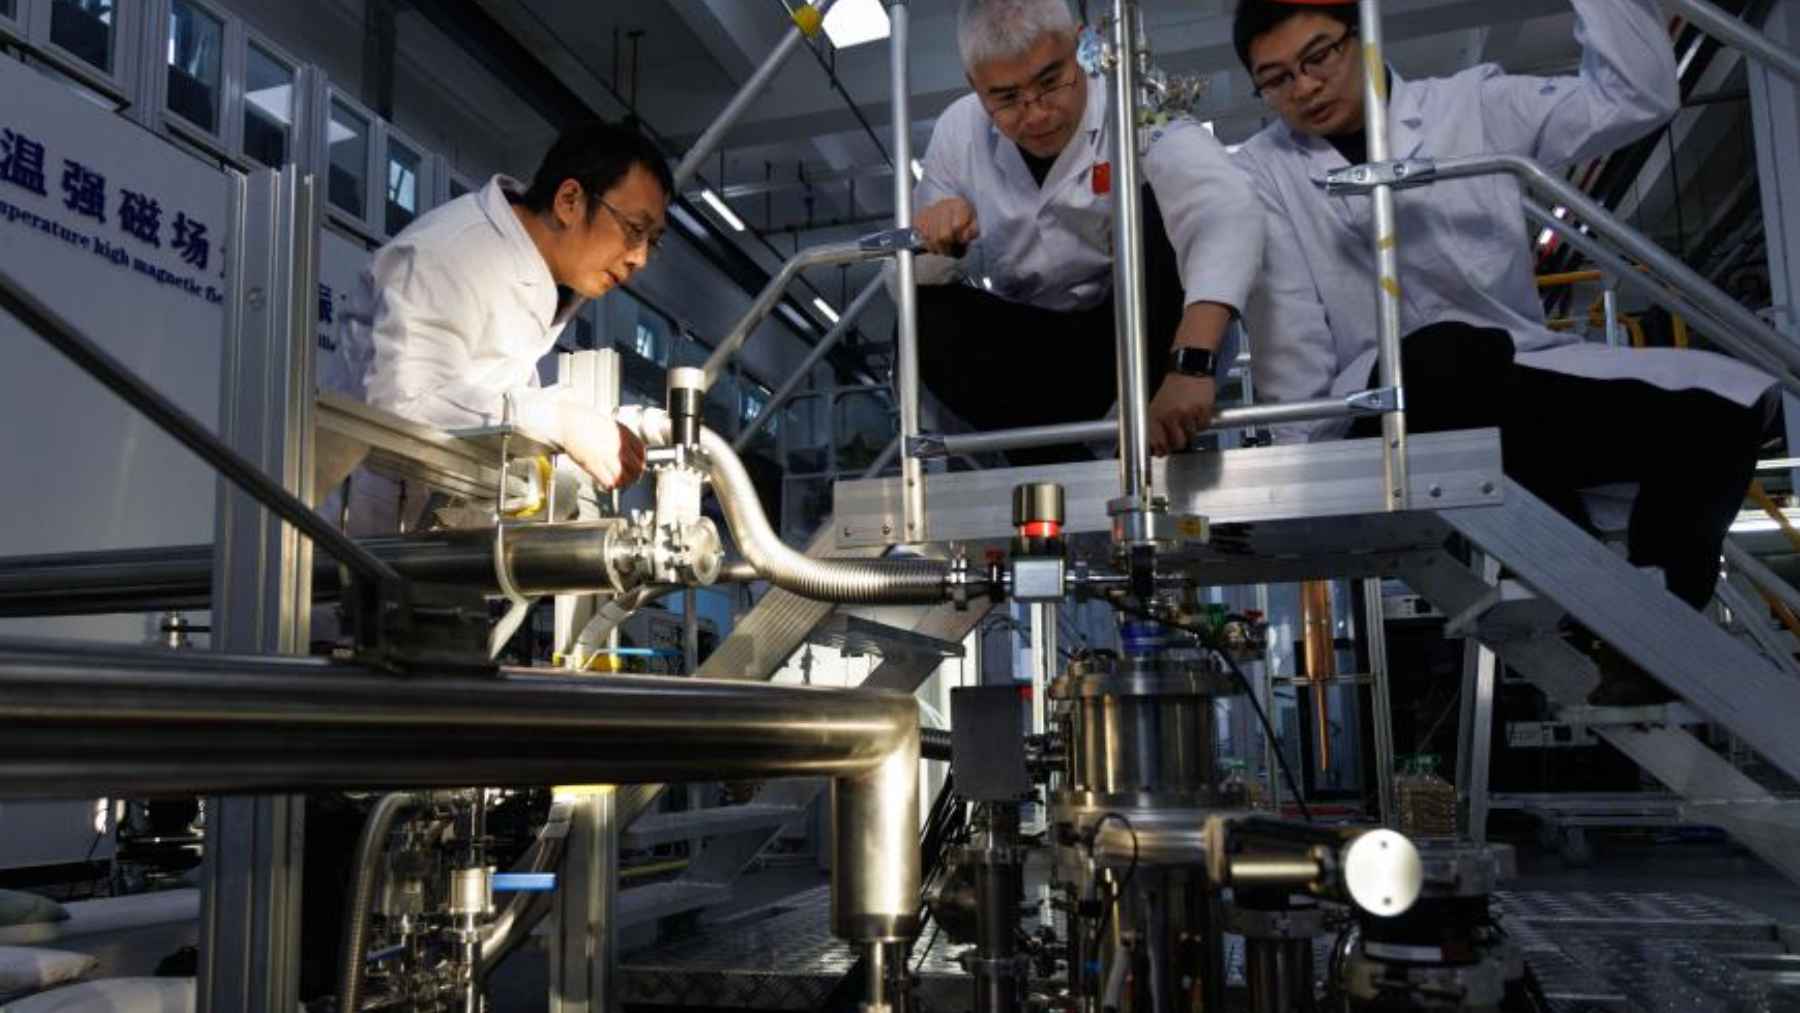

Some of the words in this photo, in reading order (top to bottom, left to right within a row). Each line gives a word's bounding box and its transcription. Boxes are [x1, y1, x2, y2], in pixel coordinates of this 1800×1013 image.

[0, 128, 224, 279] 温强磁场
[94, 236, 129, 267] high
[134, 258, 203, 298] magnetic
